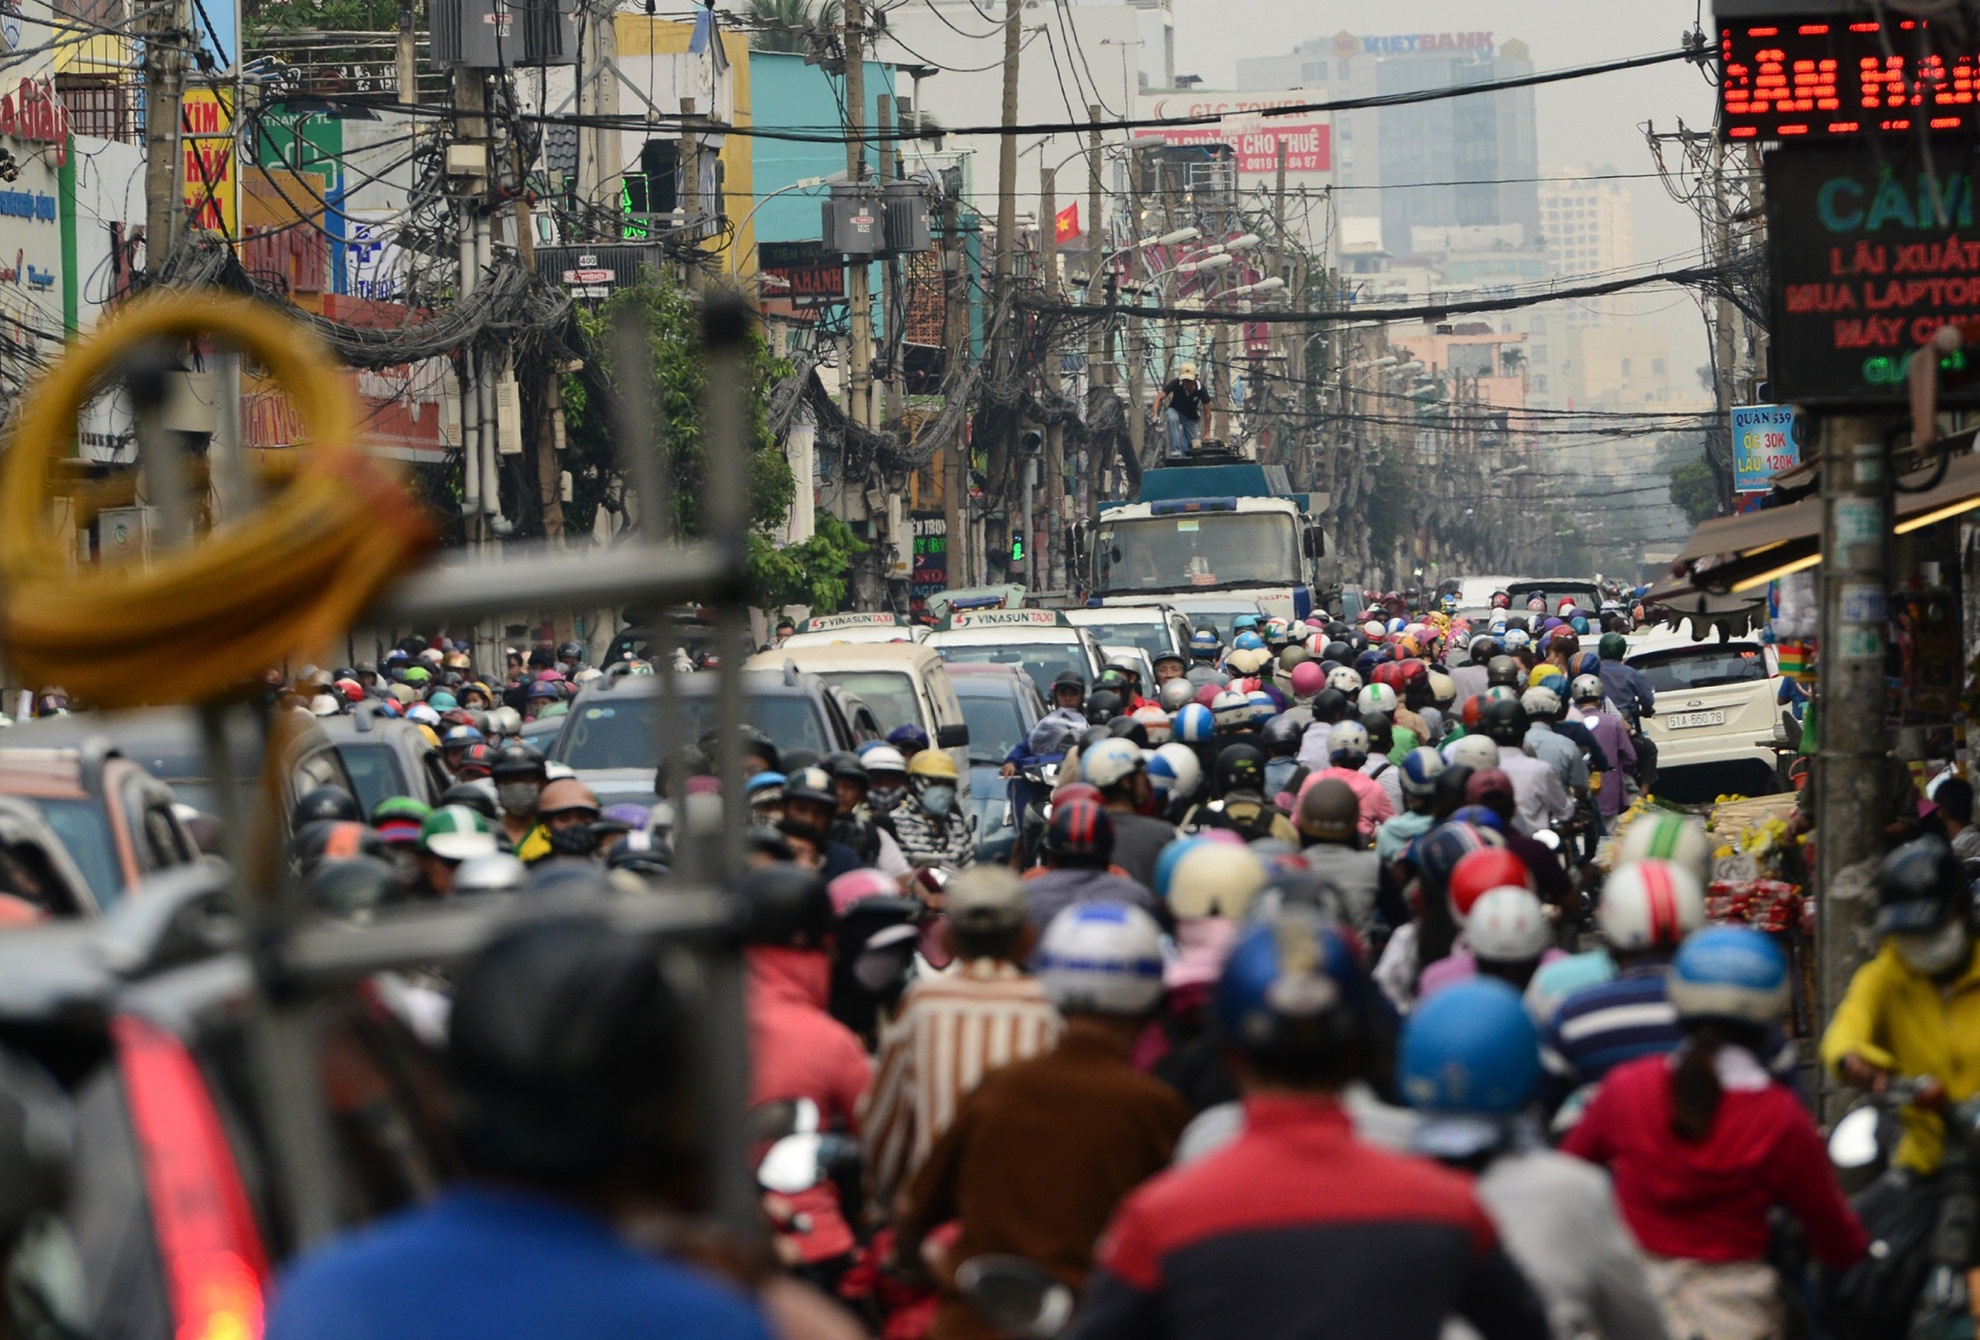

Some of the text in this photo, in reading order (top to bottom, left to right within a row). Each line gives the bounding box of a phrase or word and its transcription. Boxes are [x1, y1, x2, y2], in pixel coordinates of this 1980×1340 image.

[1236, 99, 1309, 119] TOWER
[1243, 133, 1275, 154] CHO
[1278, 127, 1319, 153] THUÊ
[580, 257, 596, 265] 400
[1773, 412, 1792, 424] 539
[1764, 432, 1787, 448] 30K
[1766, 454, 1795, 471] 120K
[872, 613, 893, 624] TAXI
[977, 611, 1054, 625] VINASUN TAXI
